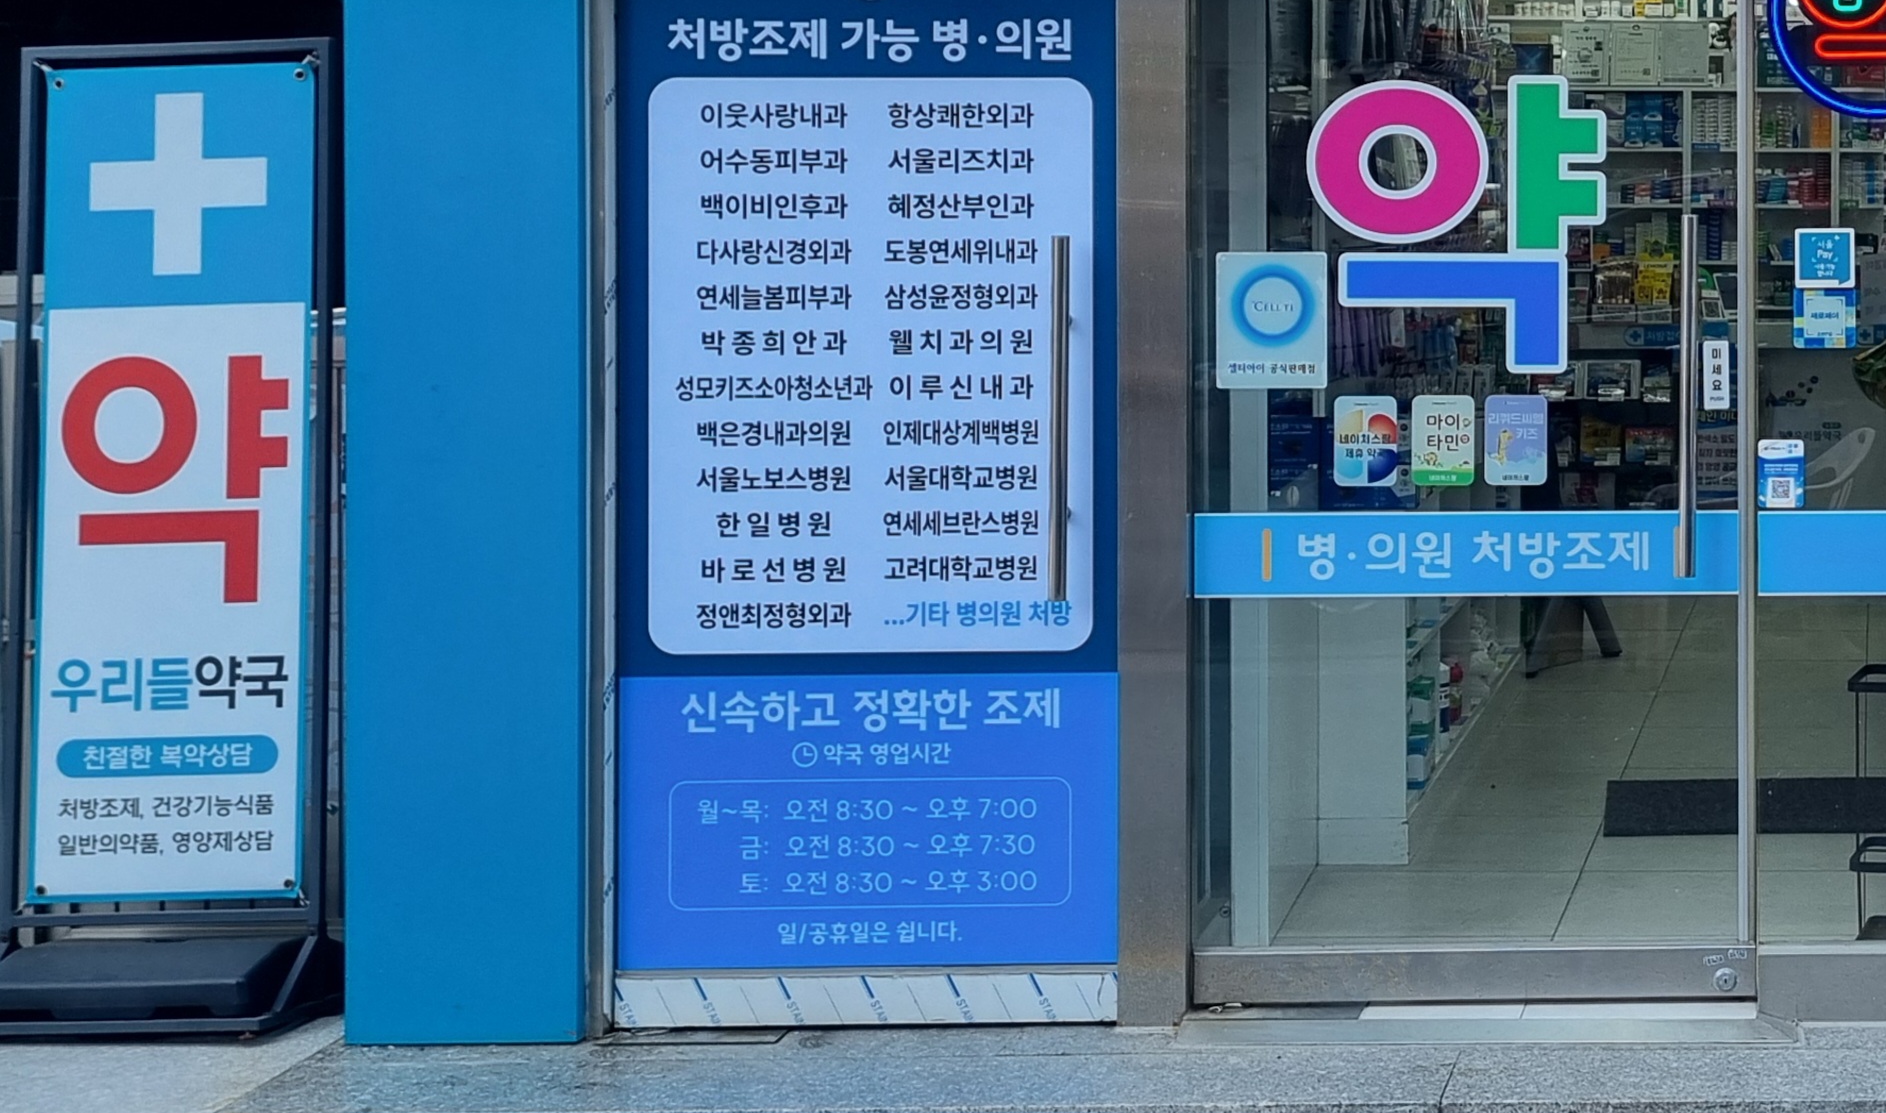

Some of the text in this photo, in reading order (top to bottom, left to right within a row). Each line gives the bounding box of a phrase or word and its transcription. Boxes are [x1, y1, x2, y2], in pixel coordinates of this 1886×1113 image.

[668, 19, 1072, 61] 처방조제 가능 병·의원
[700, 103, 847, 129] 이웃사랑내과
[888, 103, 1034, 129] 항상쾌한외과
[700, 148, 847, 174] 어수동피부과
[888, 148, 1034, 174] 서울리즈치과
[700, 194, 847, 219] 백이비인후과
[888, 194, 1034, 219] 혜정산부인과
[1307, 75, 1607, 374] 약
[696, 239, 852, 265] 다사랑신경외과
[884, 239, 1037, 265] 도봉연세위내과
[1817, 250, 1833, 260] Pay
[696, 284, 852, 311] 연세늘봄피부과
[884, 284, 1037, 311] 삼성윤정형외과
[675, 375, 872, 401] 성모키즈소아청소년과
[696, 421, 851, 448] 백은경내과의원
[883, 421, 1039, 448] 인제대상계백병원
[1427, 414, 1460, 430] 마이
[1516, 428, 1538, 439] 키즈
[1427, 434, 1459, 452] 타민
[61, 354, 290, 604] 약
[696, 465, 851, 492] 서울노보스병원
[884, 465, 1038, 492] 서울대학교병원
[883, 511, 1039, 538] 연세세브란스병원
[1297, 530, 1650, 581] 병·의원 처방조제
[884, 557, 1038, 583] 고려대학교병원
[696, 603, 851, 629] 정앤최정형외과
[957, 602, 1021, 627] 병의원
[1029, 600, 1072, 627] 처방
[51, 656, 288, 712] 우리들약국
[681, 688, 1061, 733] 신속하고 정확한 조제
[83, 743, 252, 770] 친절한 복약상담
[824, 743, 951, 766] 약국 영업시간
[58, 794, 274, 820] 처방조제, 건강기능식품
[783, 799, 828, 824] 오전
[836, 798, 892, 821] 8:30
[926, 798, 971, 821] 오후
[979, 798, 1037, 820] 7:00
[58, 830, 273, 856] 일반의약품, 영양제상담
[739, 836, 770, 857] 금:
[785, 834, 829, 859] 오전
[837, 835, 894, 857] 8:30
[926, 833, 971, 857] 오후
[980, 834, 1036, 856] 7:30
[739, 872, 770, 894] 토:
[782, 871, 828, 895] 오전
[835, 872, 892, 893] 8:30
[924, 871, 970, 895] 오후
[978, 871, 1037, 892] 3:00
[777, 919, 963, 946] 일/공휴일은 쉽니다.
